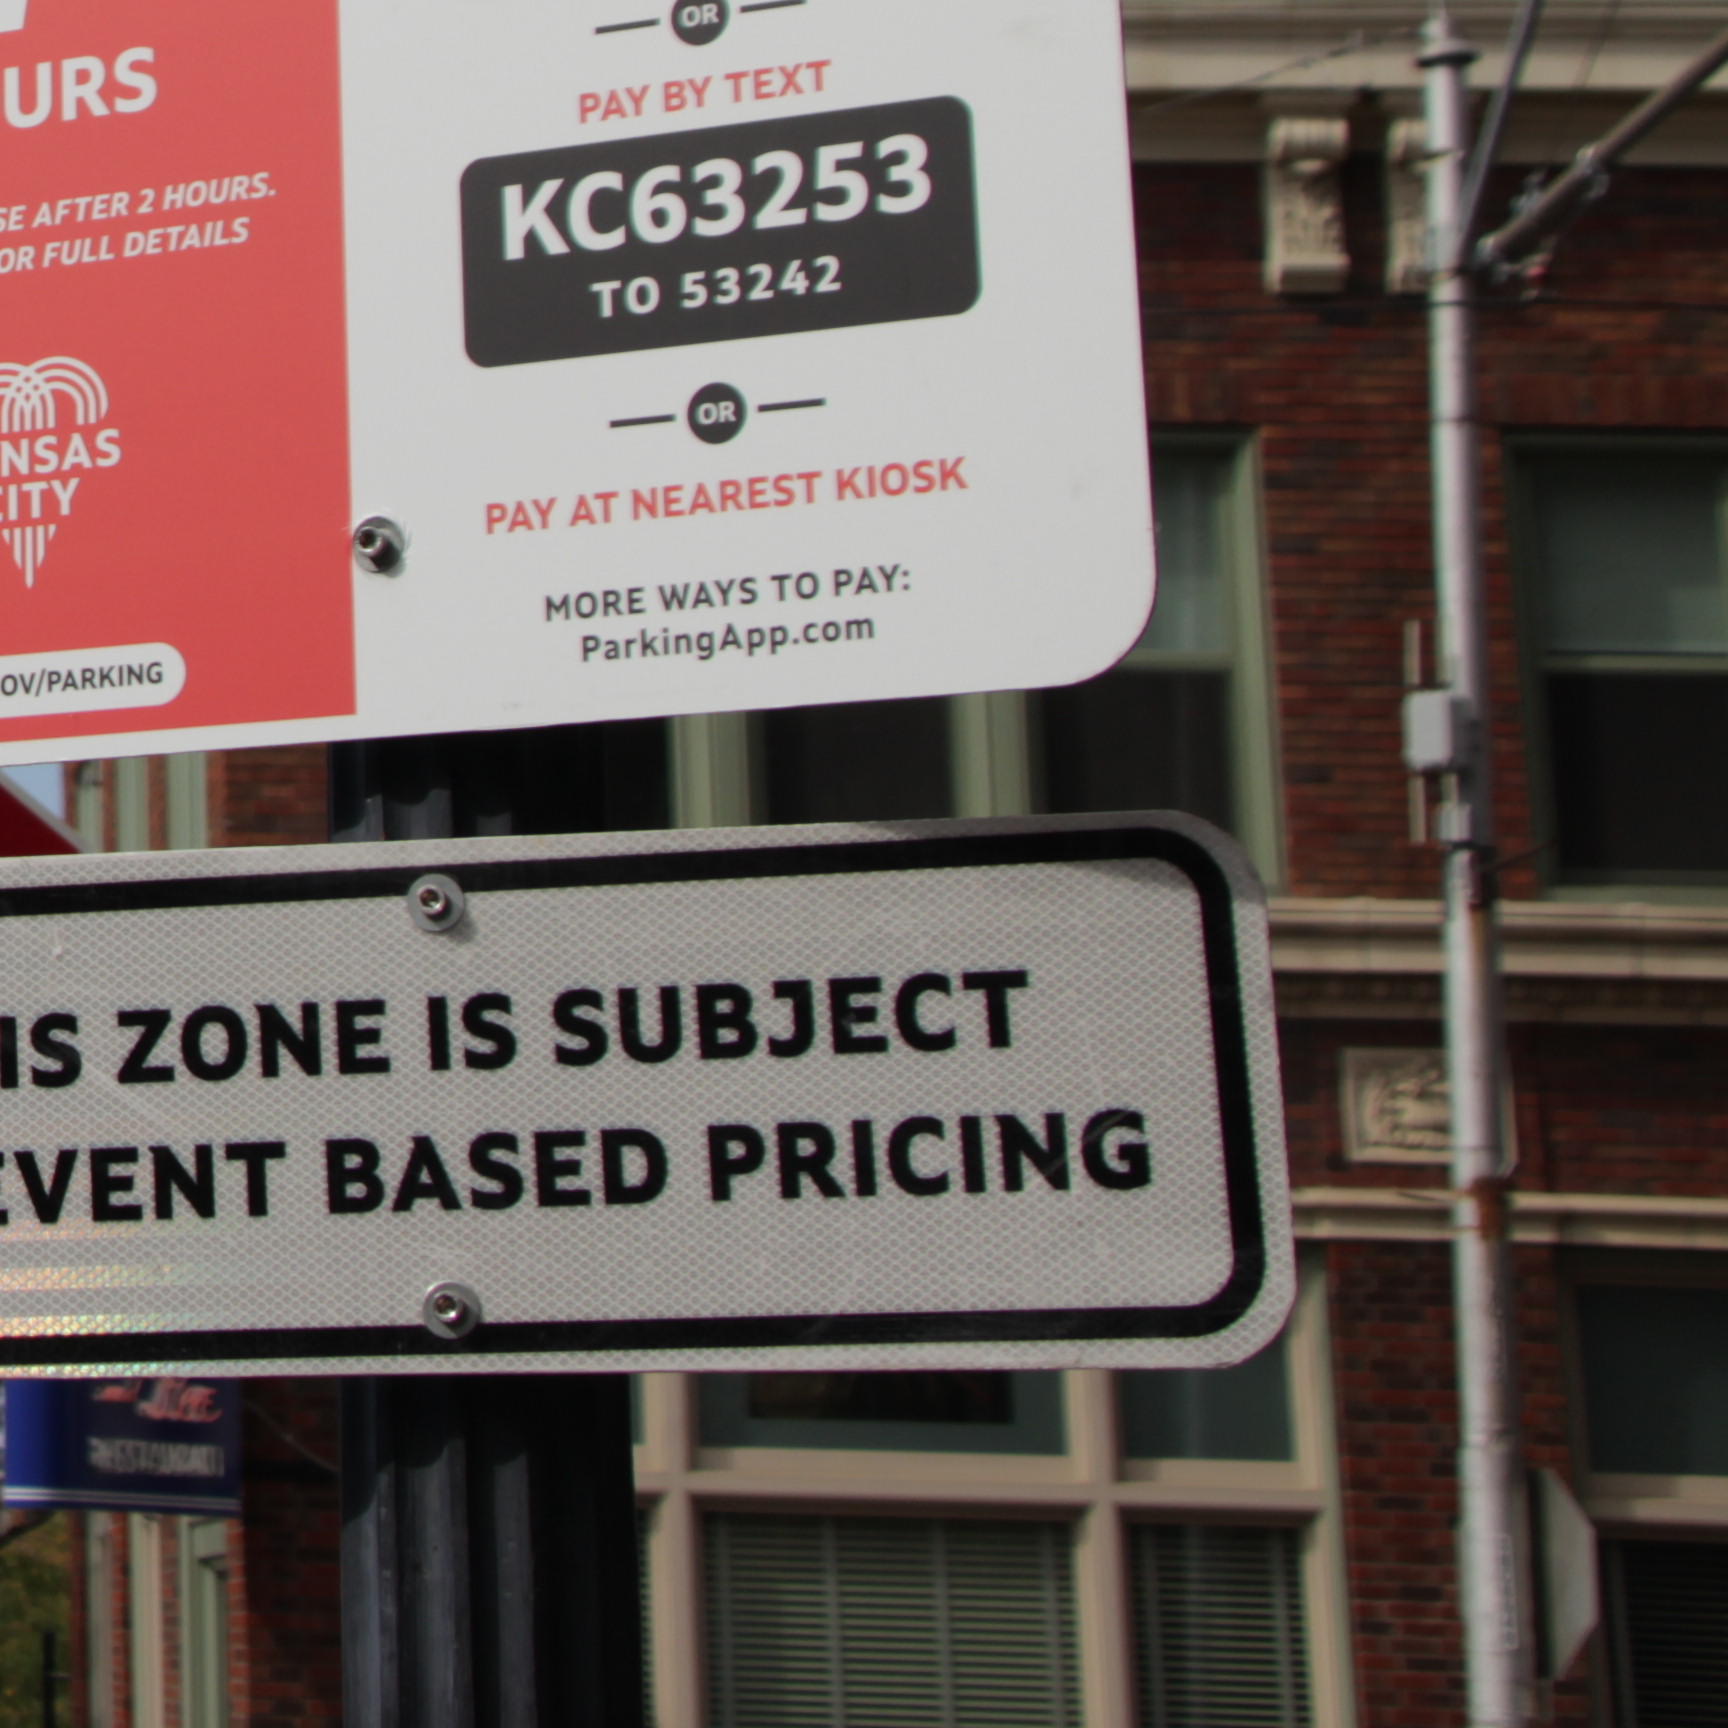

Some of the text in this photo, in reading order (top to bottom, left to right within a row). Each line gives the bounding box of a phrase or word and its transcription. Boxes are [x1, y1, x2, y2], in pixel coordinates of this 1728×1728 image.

[682, 2, 719, 28] OR
[579, 61, 832, 122] PAY BY TEXT
[32, 189, 129, 228] AFTER
[138, 188, 155, 214] 2
[163, 173, 276, 210] HOURS.
[500, 134, 932, 260] KC63253
[42, 235, 115, 268] FULL
[123, 217, 249, 257] DETAILS
[590, 254, 842, 320] TO 53242
[698, 400, 736, 427] OR
[486, 457, 968, 535] PAY AT NEAREST KIOSK
[545, 564, 911, 621] MORE WAYS TO PAY:
[581, 617, 875, 662] ParkingApp.com
[116, 1000, 392, 1086] ZONE
[427, 990, 520, 1074] IS
[552, 969, 1029, 1068] SUBJECT
[325, 1128, 669, 1216] BASED
[707, 1108, 1154, 1204] PRICING
